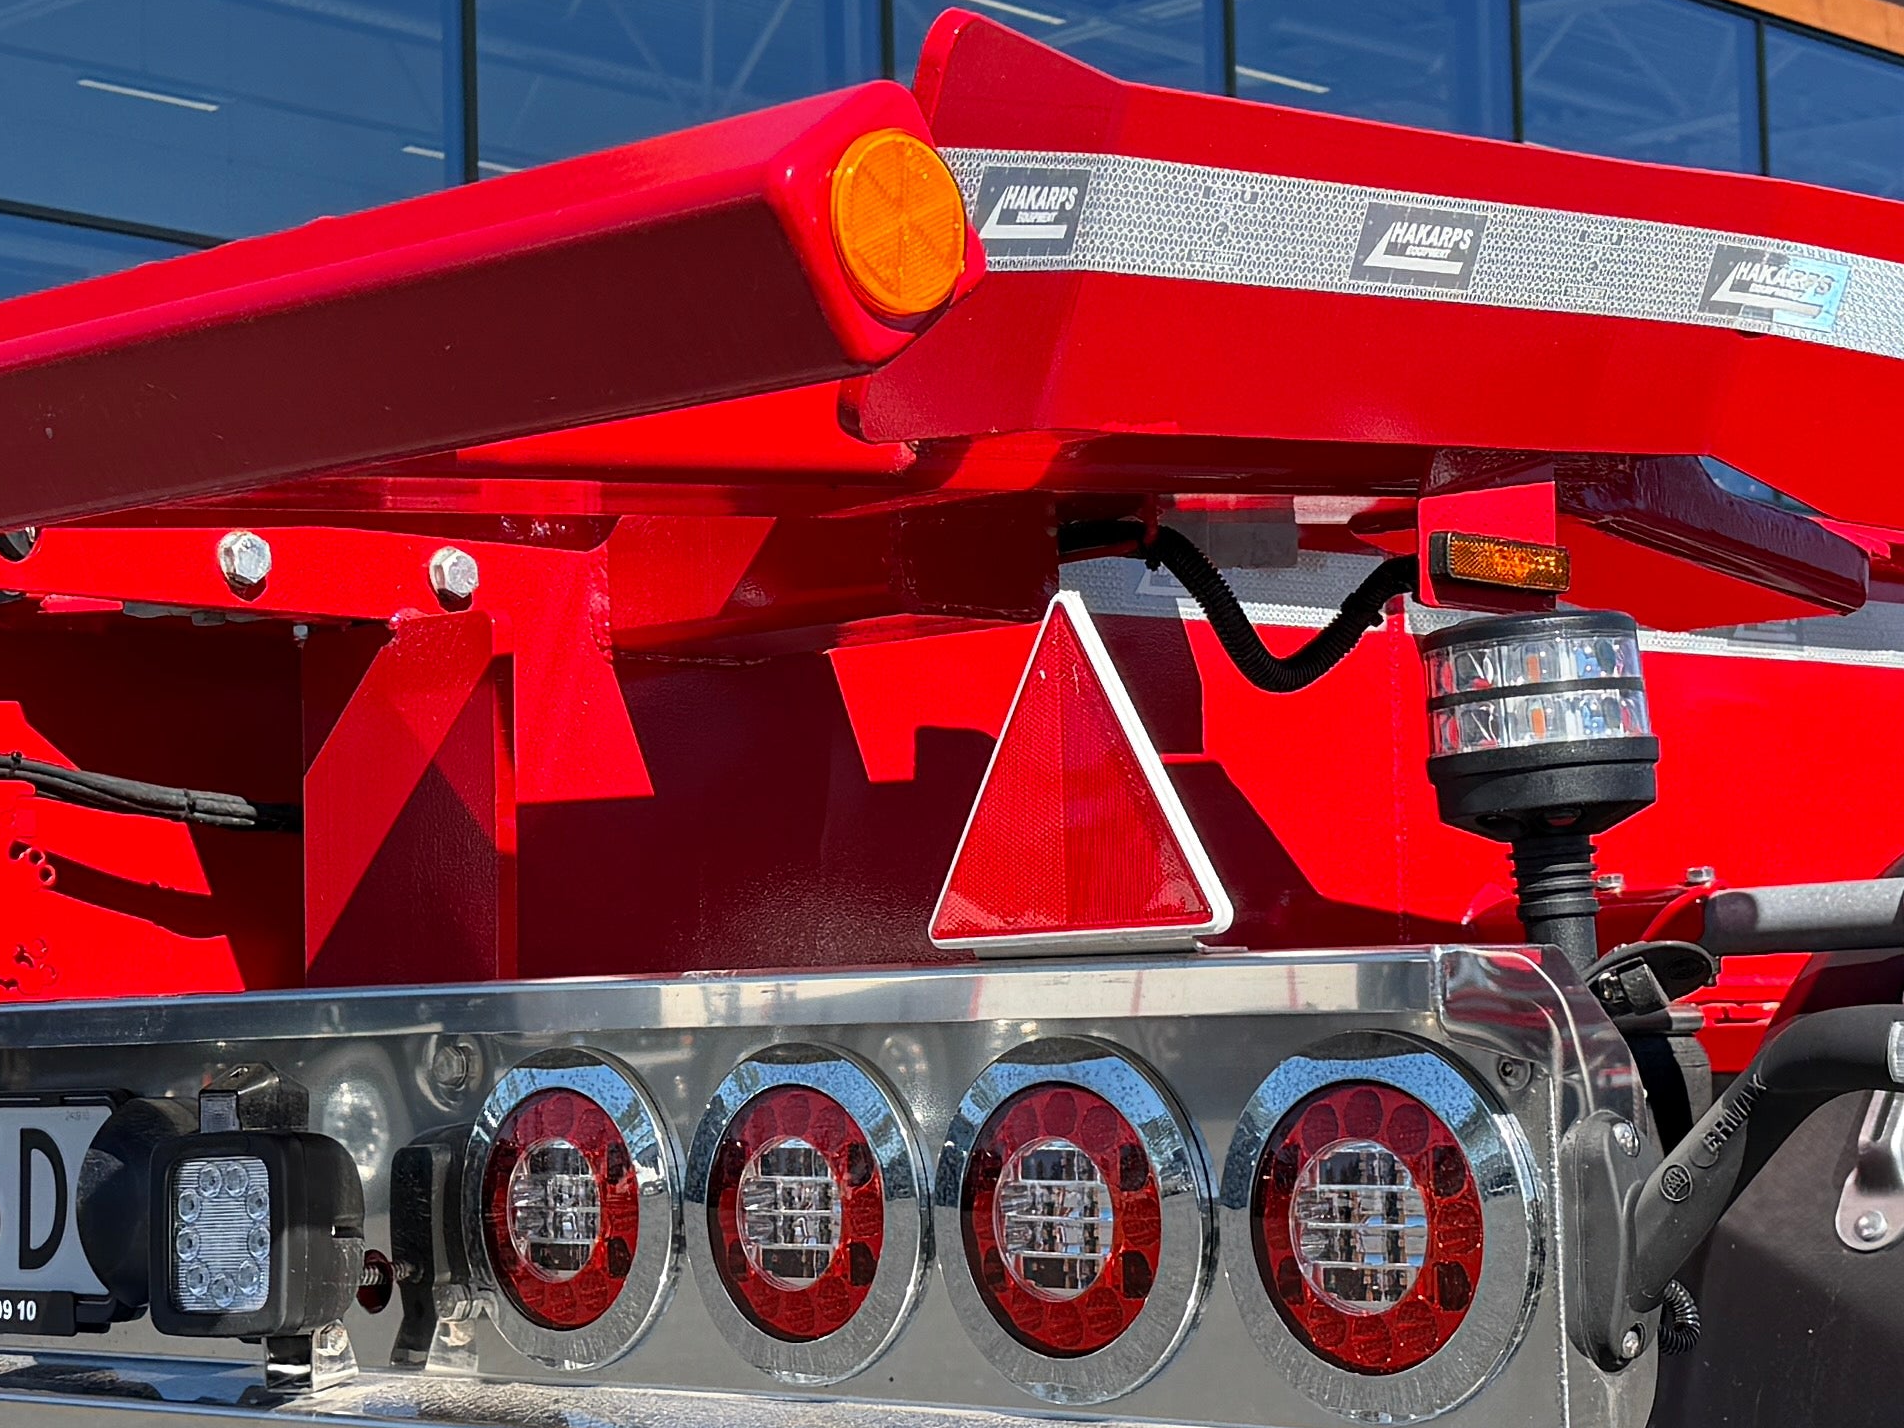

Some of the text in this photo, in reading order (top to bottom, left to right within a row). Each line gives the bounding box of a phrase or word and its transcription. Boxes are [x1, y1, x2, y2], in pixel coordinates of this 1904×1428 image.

[1003, 185, 1078, 211] HAKARPS
[1390, 222, 1474, 250] HAKARPS
[1735, 261, 1834, 296] HAKARPS
[17, 1300, 36, 1321] 10
